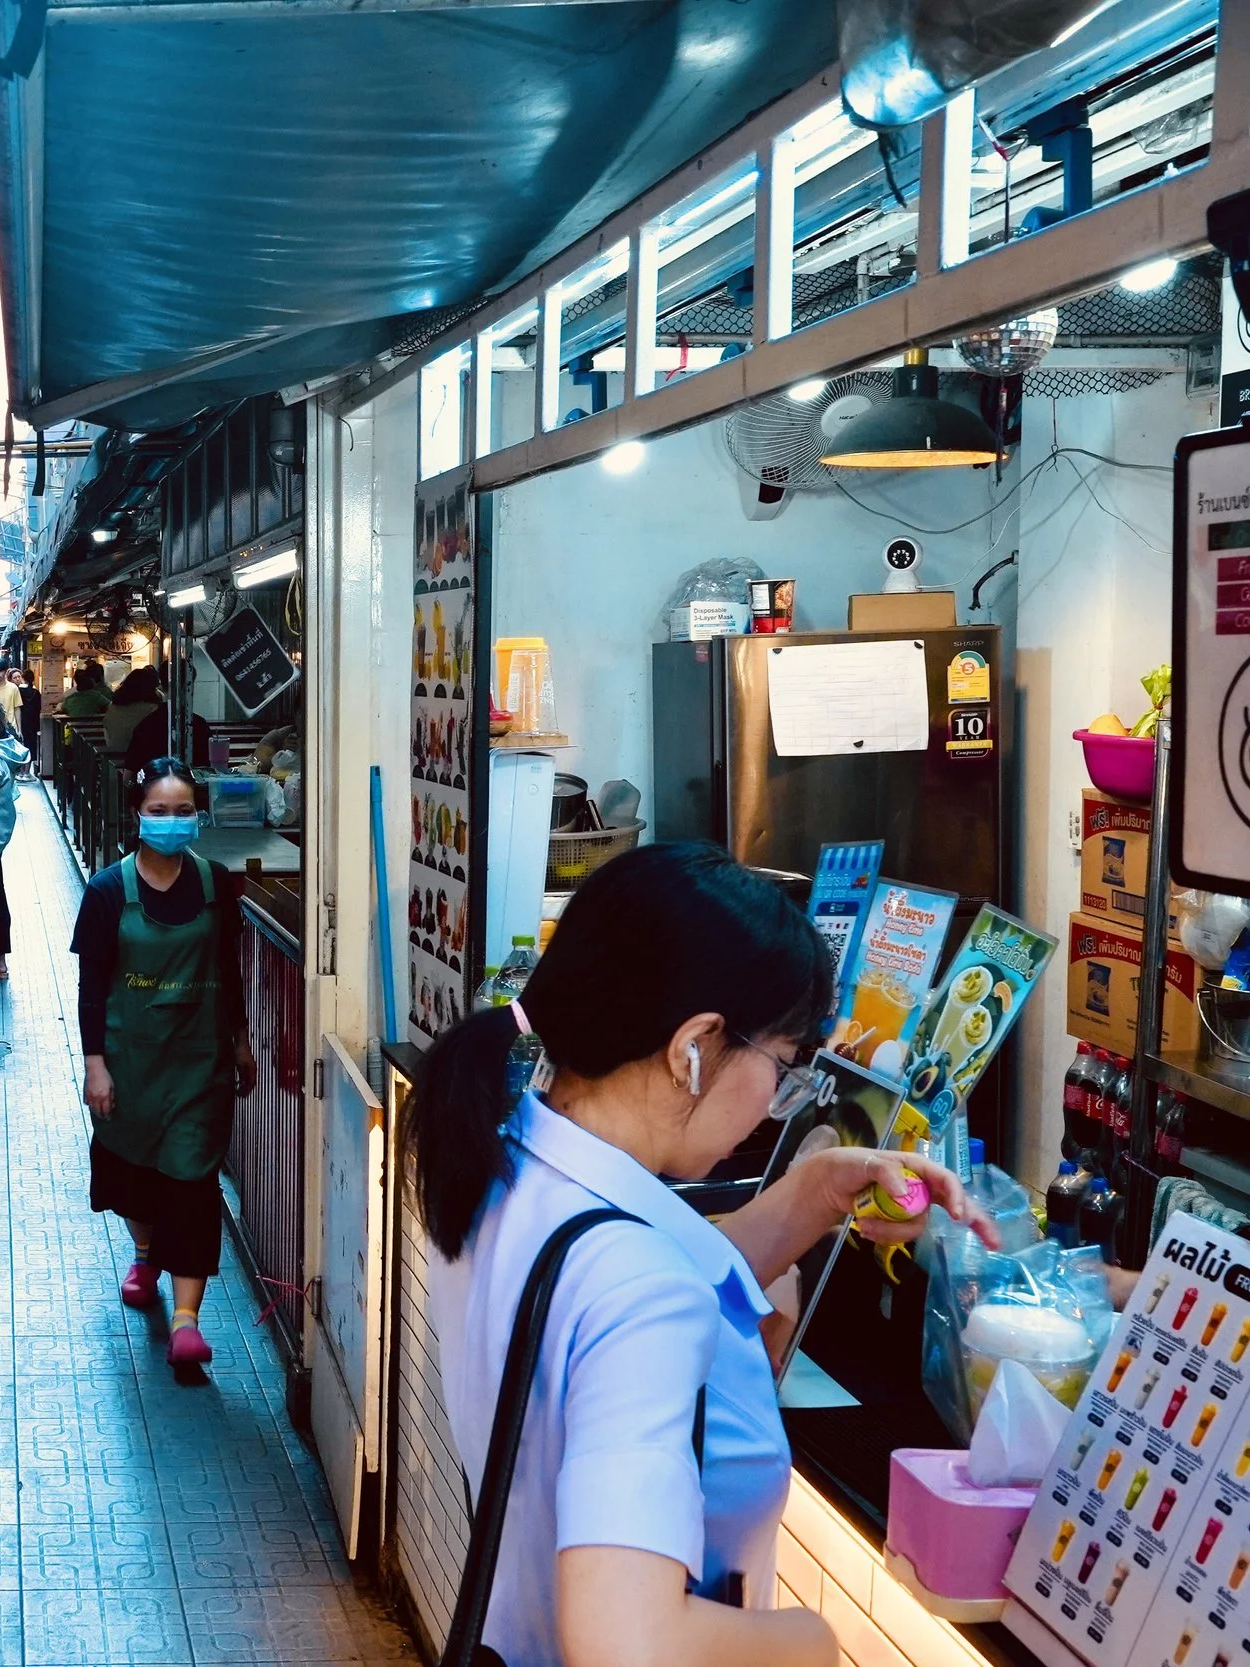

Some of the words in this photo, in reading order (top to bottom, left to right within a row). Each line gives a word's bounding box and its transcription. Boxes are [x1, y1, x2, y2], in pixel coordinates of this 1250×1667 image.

[955, 717, 984, 736] 10
[1090, 807, 1109, 831] ฟรี!
[1163, 1237, 1232, 1283] ผลไม้
[1234, 1273, 1250, 1293] FR
